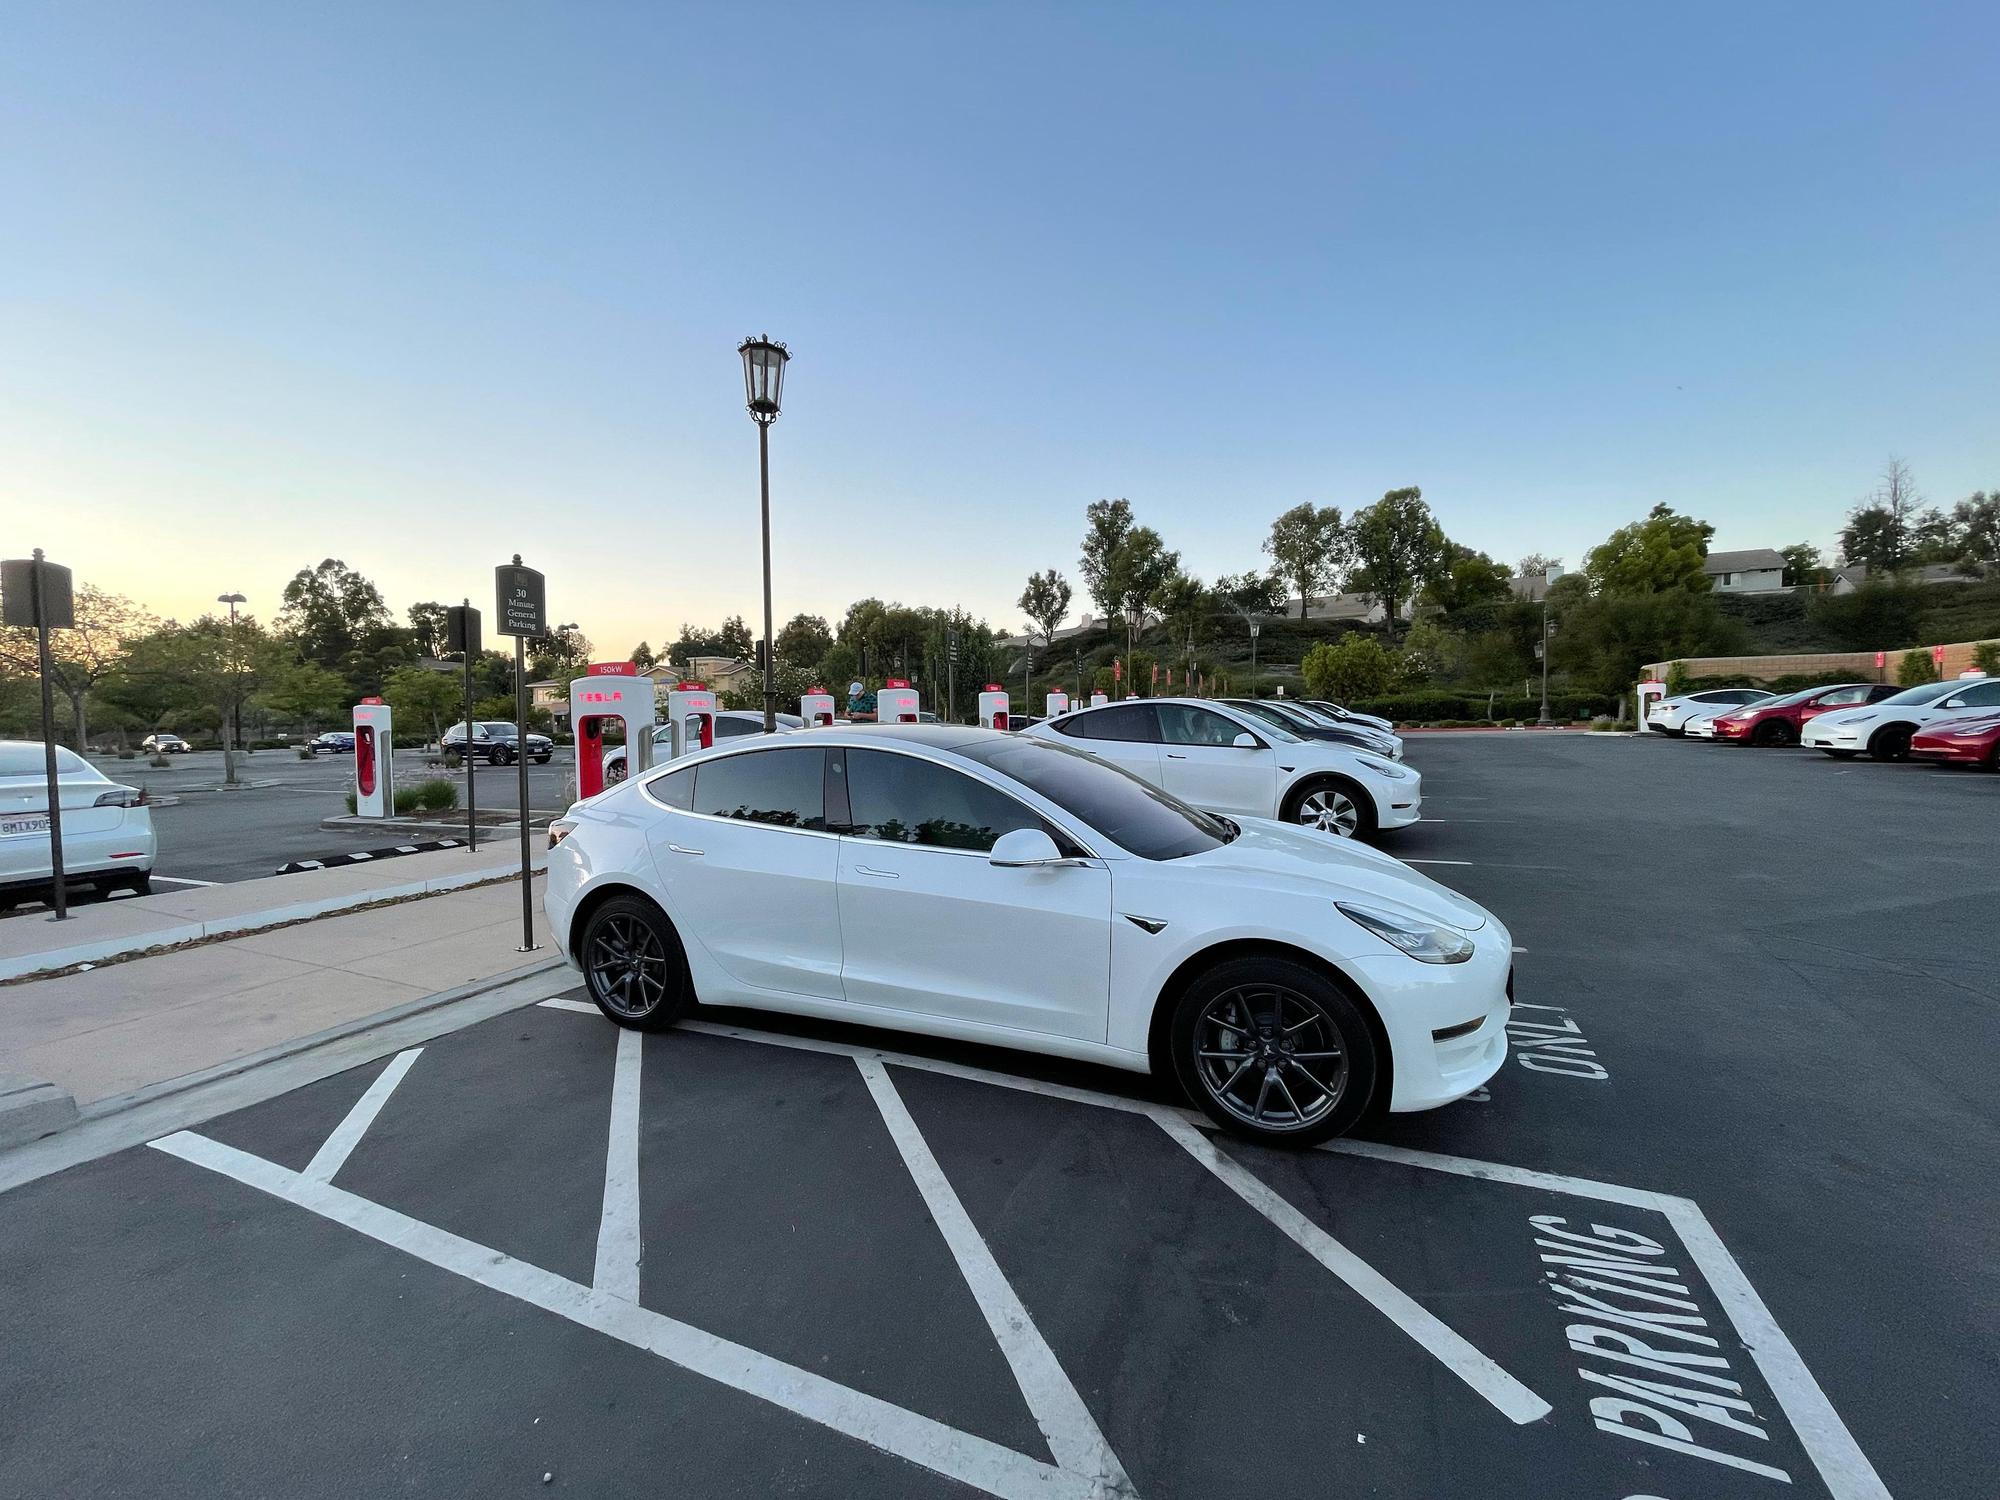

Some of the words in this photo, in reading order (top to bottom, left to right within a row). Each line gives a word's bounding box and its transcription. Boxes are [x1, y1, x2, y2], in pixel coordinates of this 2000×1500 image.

[515, 588, 527, 598] 30
[508, 598, 535, 609] Minute
[507, 608, 536, 619] General
[508, 619, 536, 631] Parking
[600, 665, 623, 674] 150kW
[578, 691, 623, 702] TESLA
[1528, 1214, 1793, 1485] PARKING
